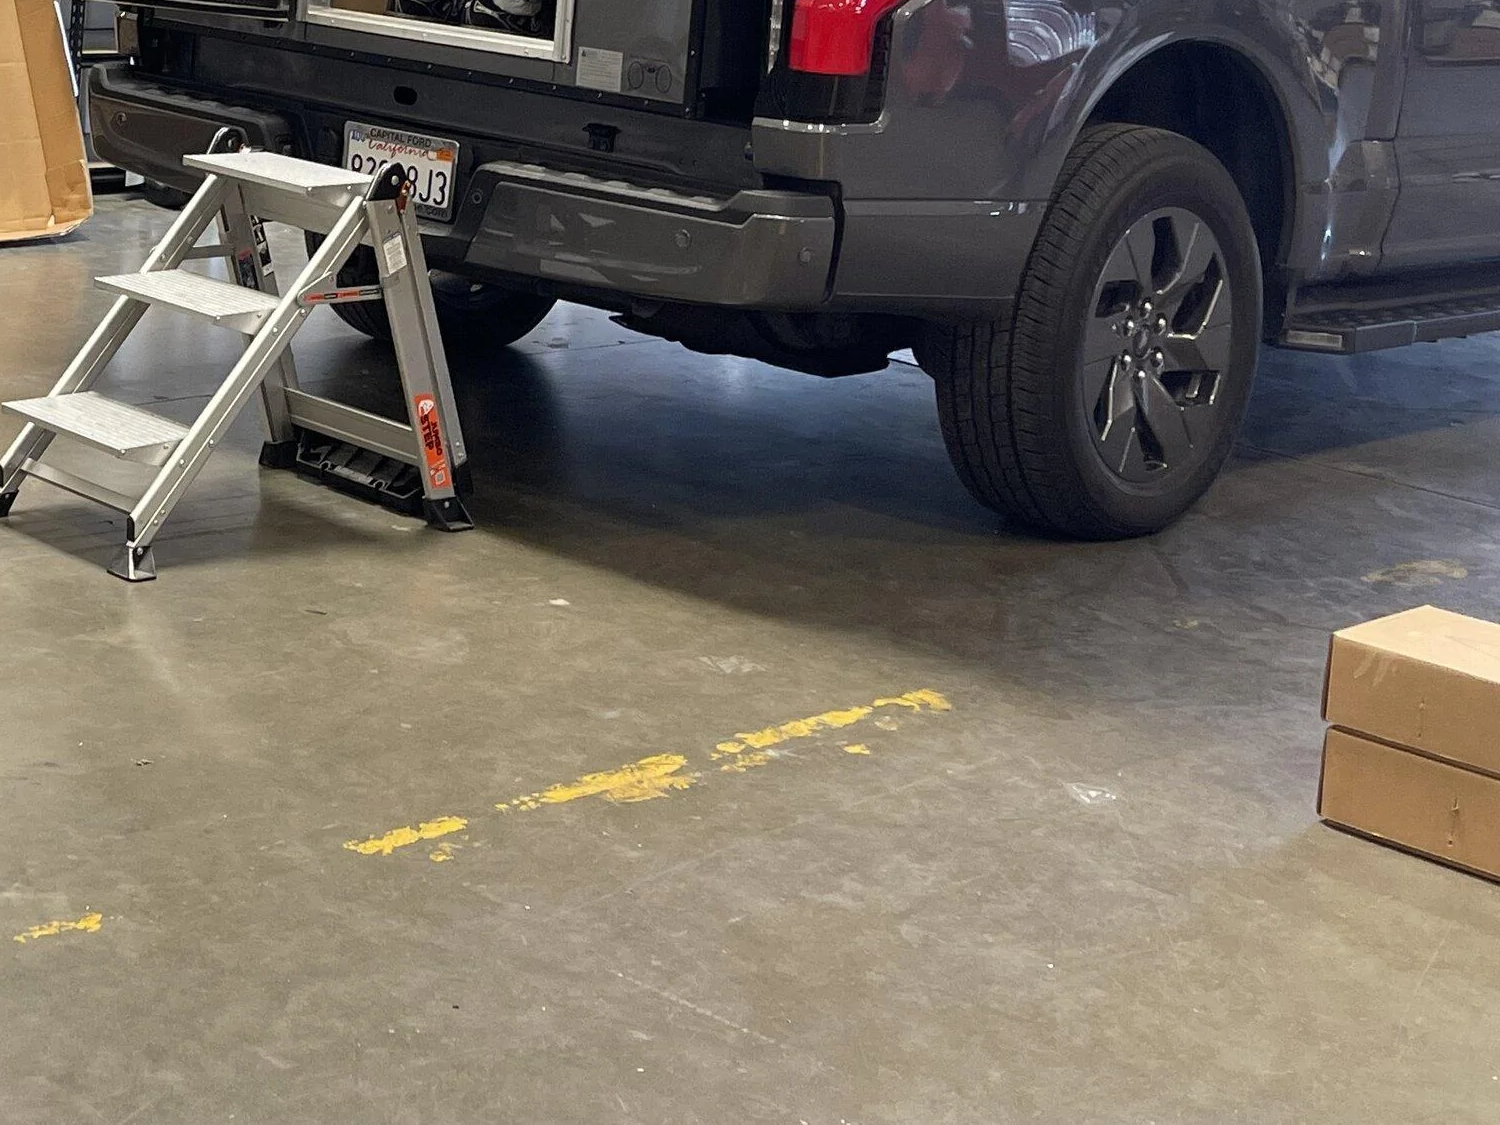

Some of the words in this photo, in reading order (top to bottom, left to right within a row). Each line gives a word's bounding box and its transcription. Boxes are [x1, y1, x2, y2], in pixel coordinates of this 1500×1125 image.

[370, 128, 405, 143] CAPITAL
[407, 135, 431, 148] FORD
[367, 139, 429, 158] California
[421, 414, 434, 450] STEP
